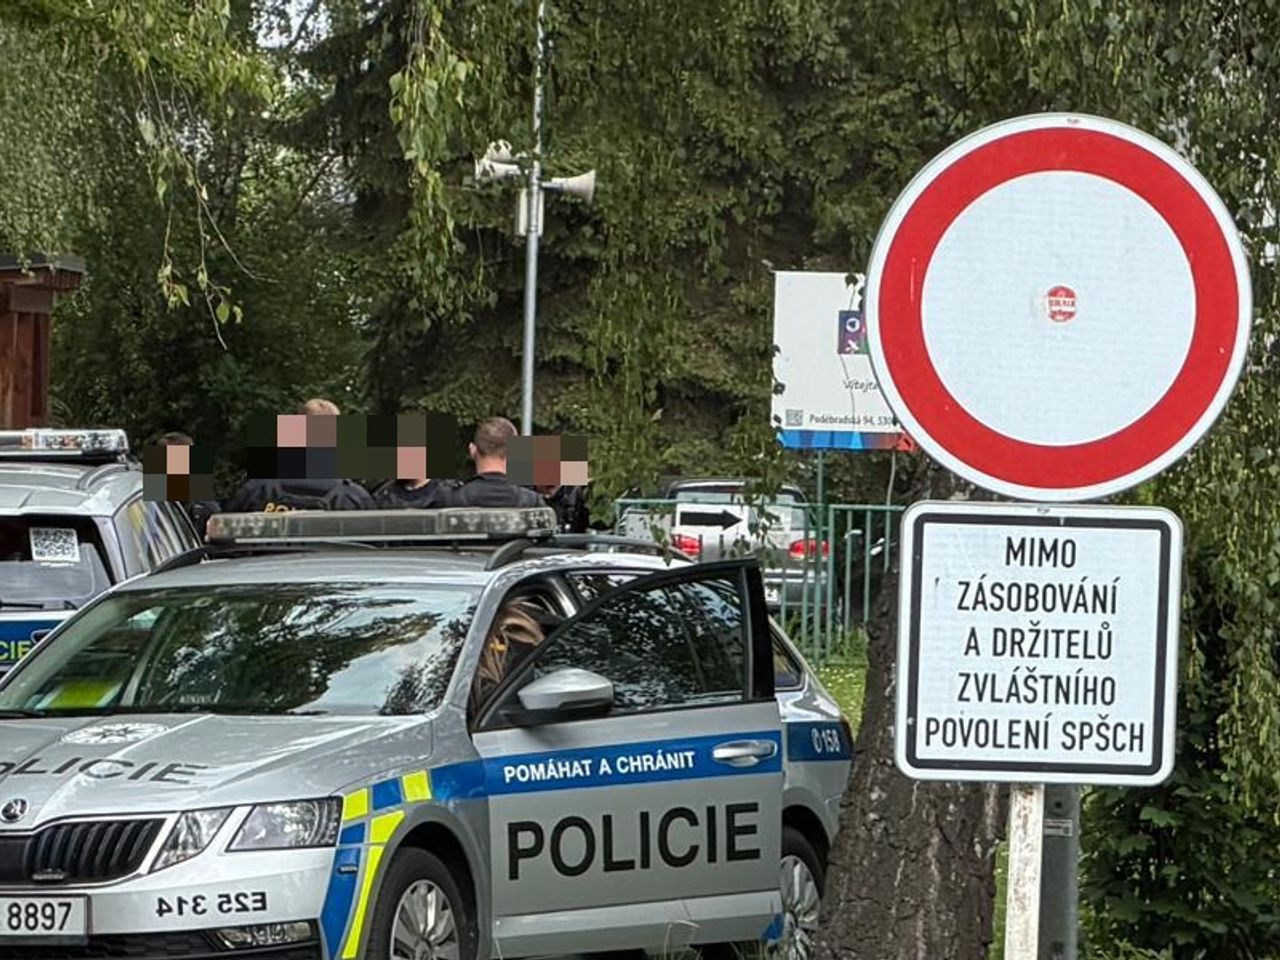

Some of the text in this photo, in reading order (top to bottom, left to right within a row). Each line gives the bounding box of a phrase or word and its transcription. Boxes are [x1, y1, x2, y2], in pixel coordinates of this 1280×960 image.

[1005, 537, 1077, 568] MIMO
[957, 574, 1121, 614] ZÁSOBOVÁNÍ
[963, 620, 1113, 660] A DRŽITELŮ
[957, 665, 1116, 706] ZVLÁŠTNÍHO
[821, 729, 840, 753] 158
[925, 712, 1145, 753] POVOLENÍ SPŠCH
[503, 749, 696, 784] POMÁHAT A CHRÁNIT
[507, 802, 761, 881] POLICIE
[7, 902, 73, 931] 8897
